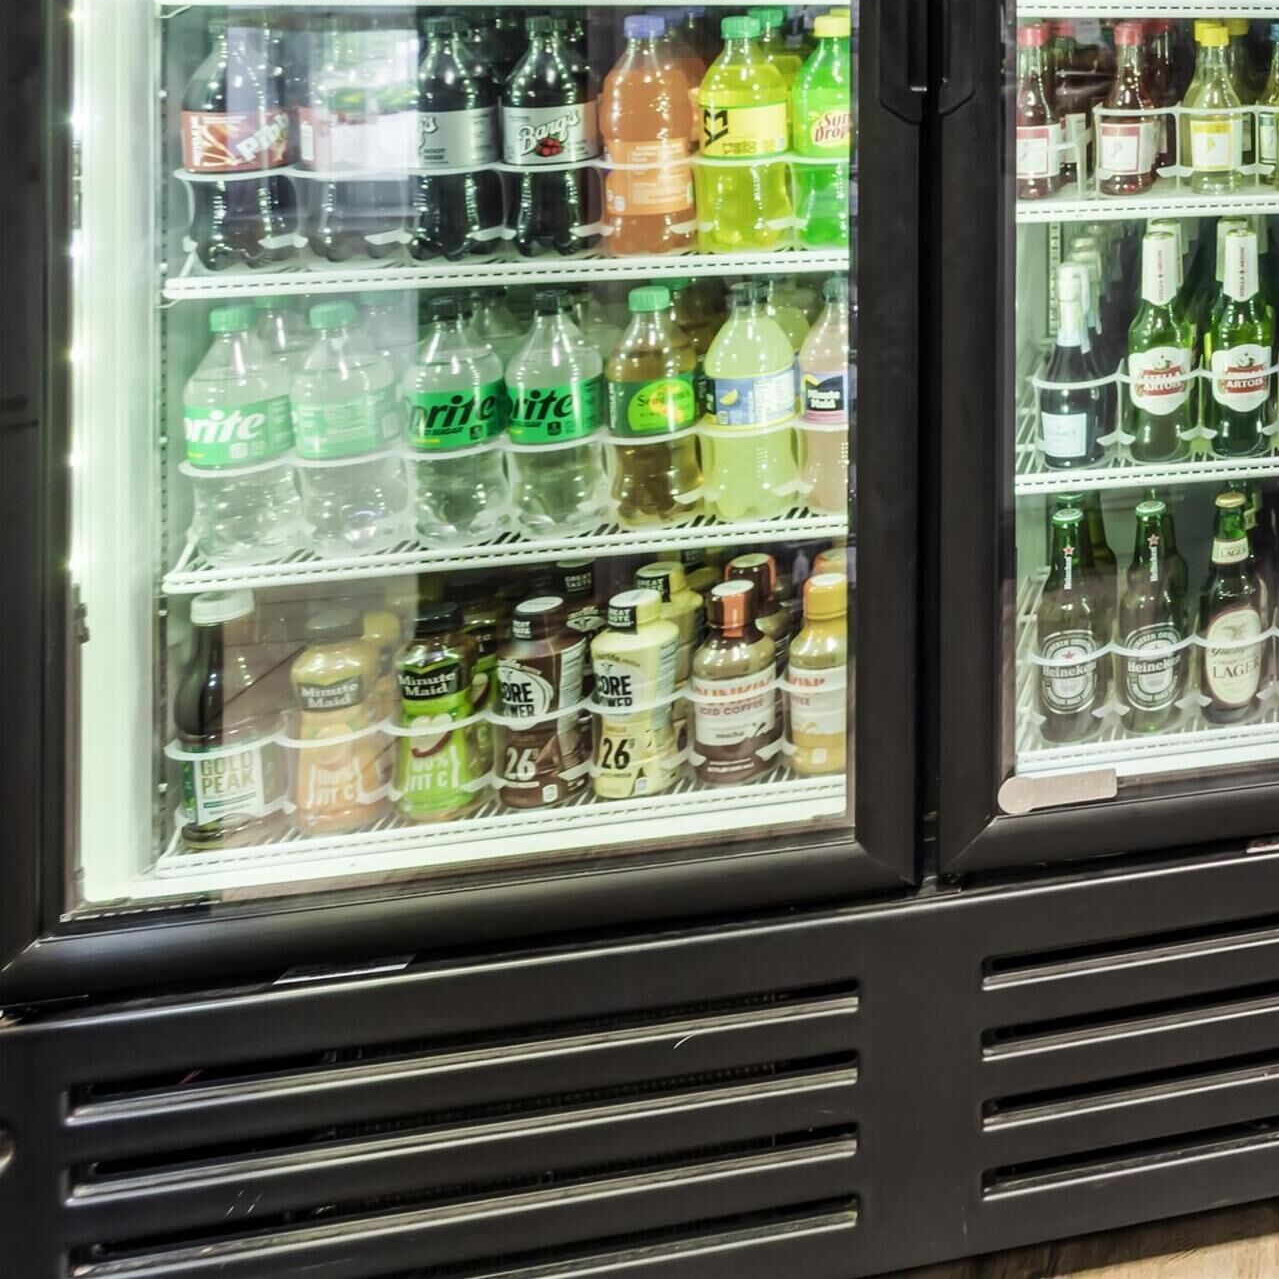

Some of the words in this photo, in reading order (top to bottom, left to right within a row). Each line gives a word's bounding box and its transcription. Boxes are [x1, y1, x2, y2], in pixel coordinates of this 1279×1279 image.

[1226, 377, 1265, 390] ARTOIS
[411, 393, 497, 434] prite
[507, 390, 574, 422] prite
[184, 409, 266, 444] rite
[1042, 660, 1098, 678] Heineken
[1127, 655, 1182, 673] Heineken
[1212, 652, 1260, 680] LAGER
[398, 672, 456, 687] Minute
[300, 682, 359, 699] Minute
[404, 683, 449, 698] Maid
[306, 696, 352, 709] Maid
[201, 754, 252, 777] GOLD
[202, 771, 255, 795] PEAK
